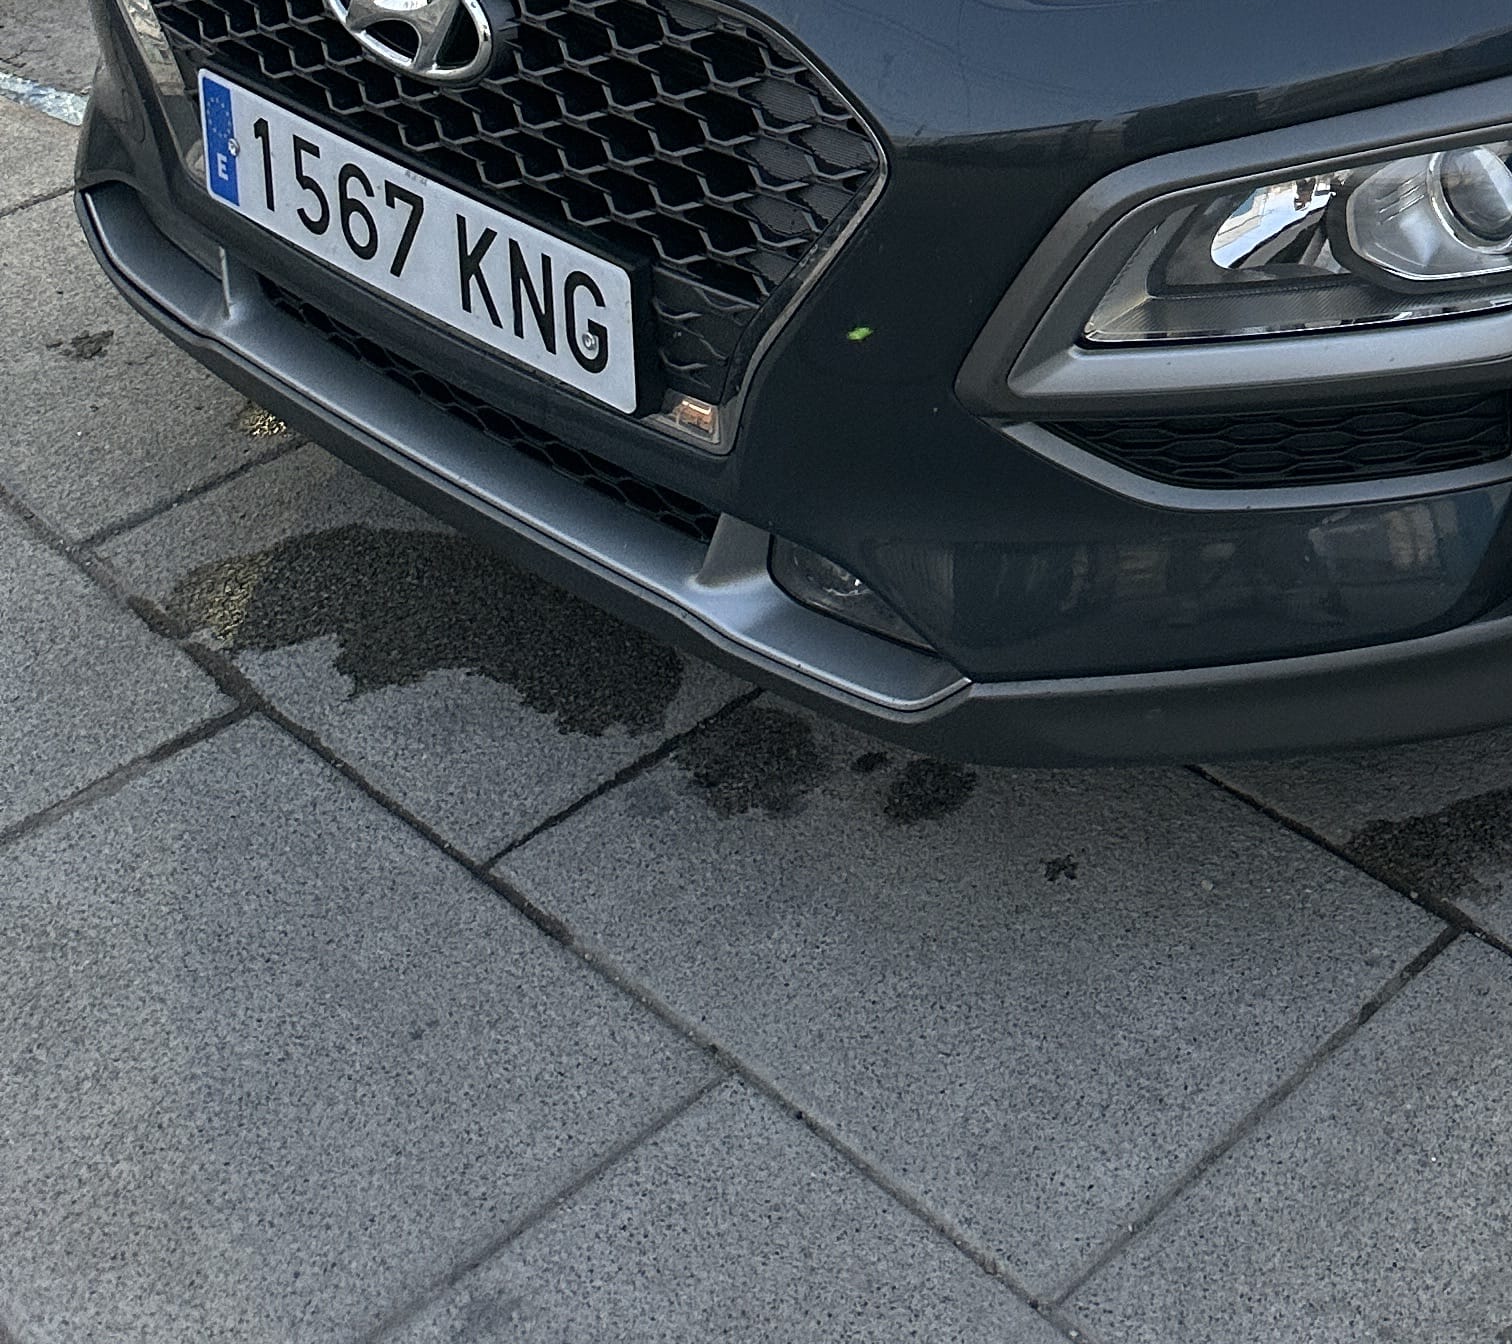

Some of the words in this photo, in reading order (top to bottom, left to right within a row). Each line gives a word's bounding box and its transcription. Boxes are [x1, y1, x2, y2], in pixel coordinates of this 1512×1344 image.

[216, 152, 229, 182] E
[253, 116, 425, 279] 1567
[456, 213, 609, 374] KNG
